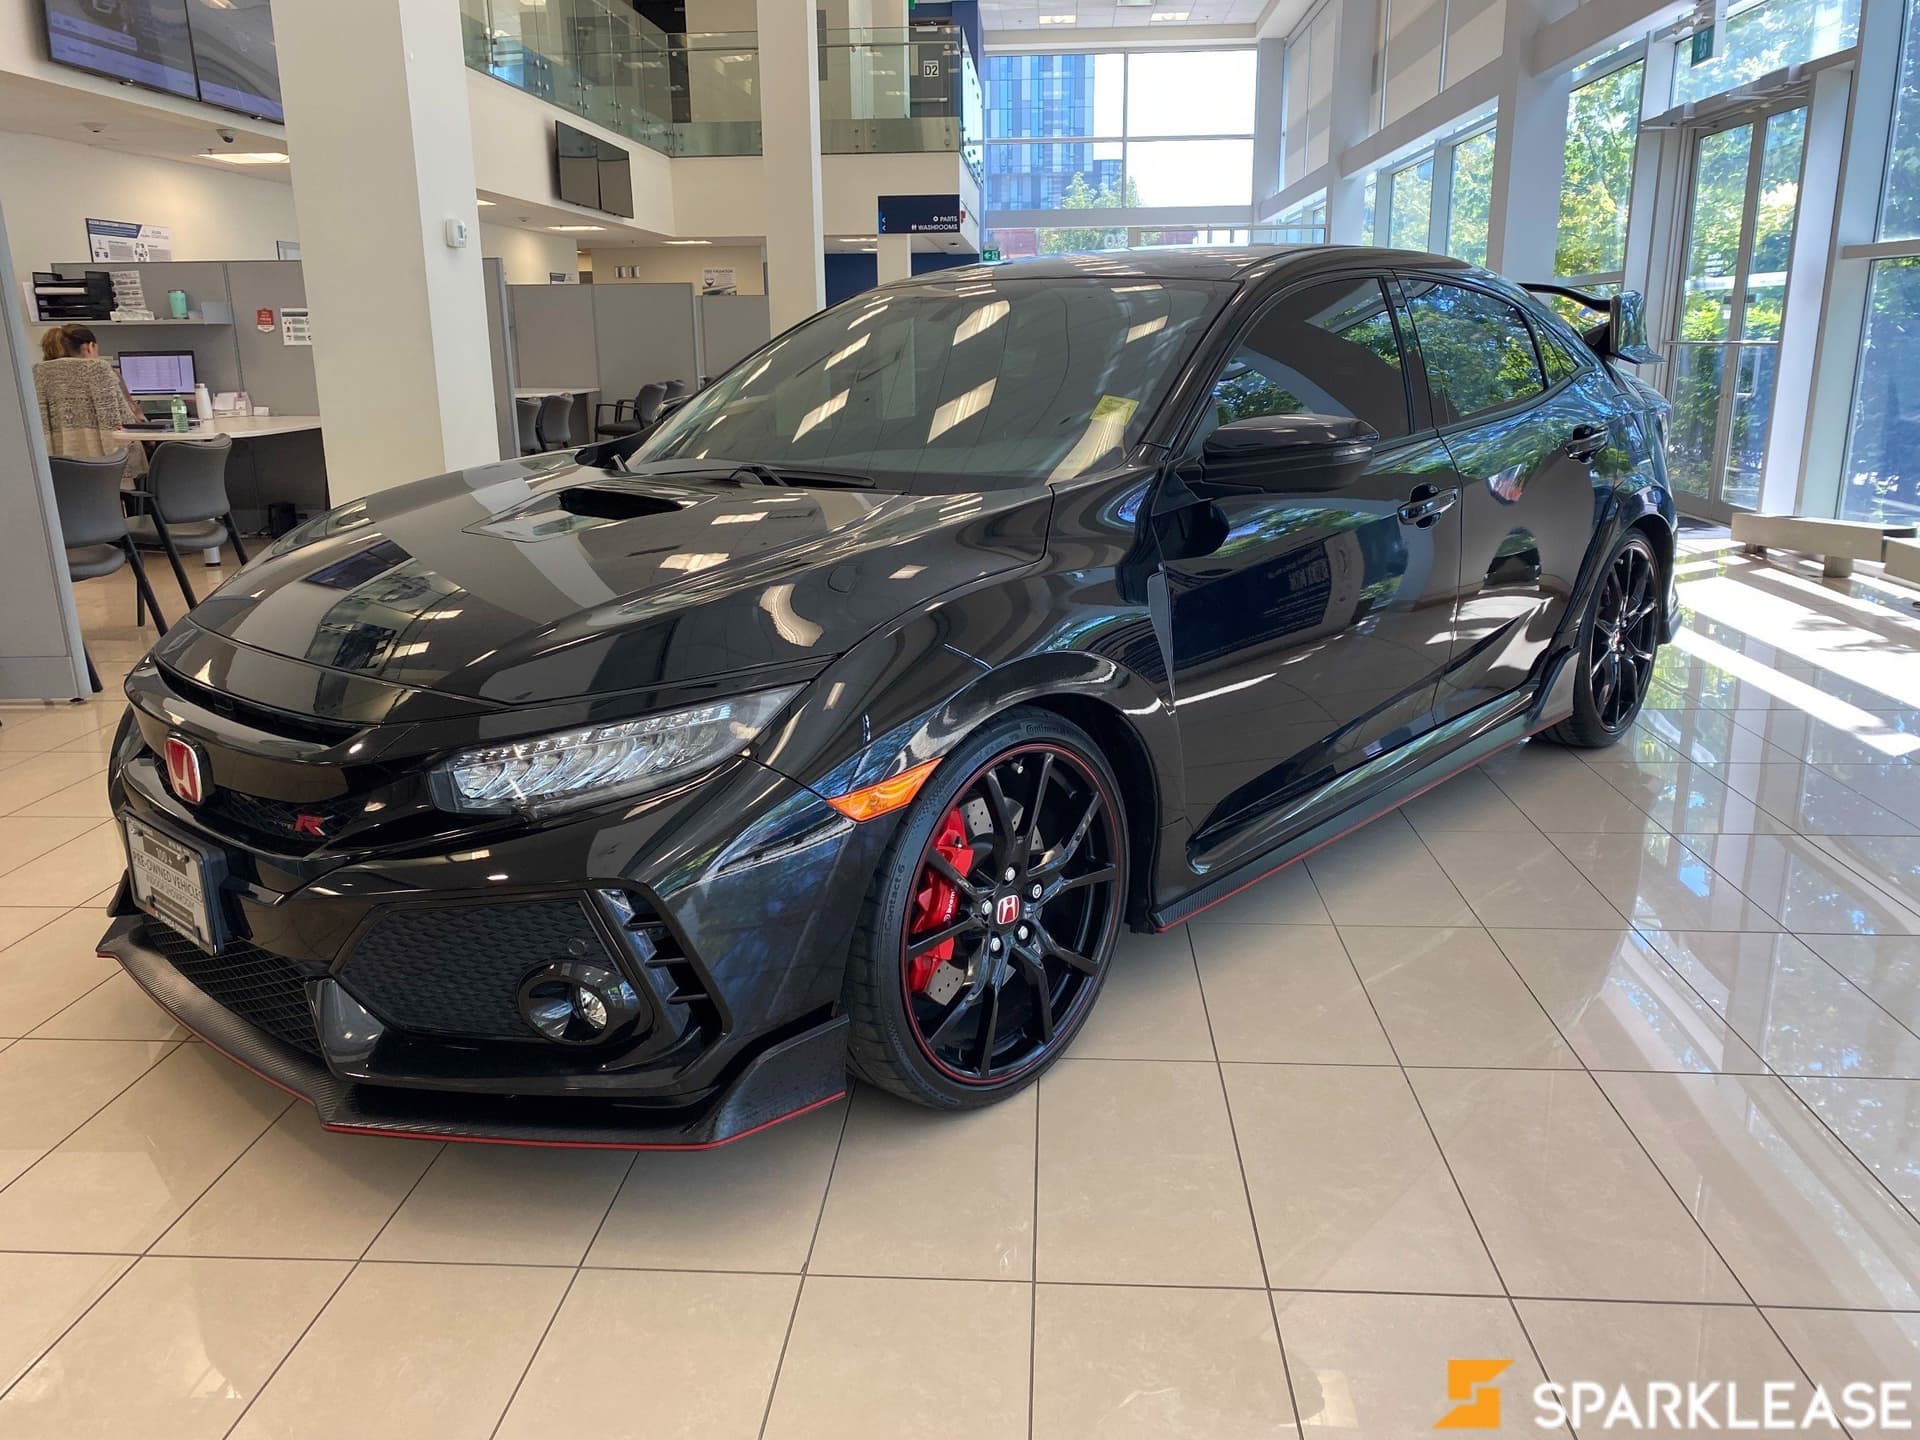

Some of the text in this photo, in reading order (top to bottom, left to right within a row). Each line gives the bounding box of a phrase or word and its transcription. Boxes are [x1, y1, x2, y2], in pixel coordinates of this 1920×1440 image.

[925, 64, 938, 76] D2
[940, 215, 958, 223] PARTS
[918, 223, 958, 231] WASHROOMS
